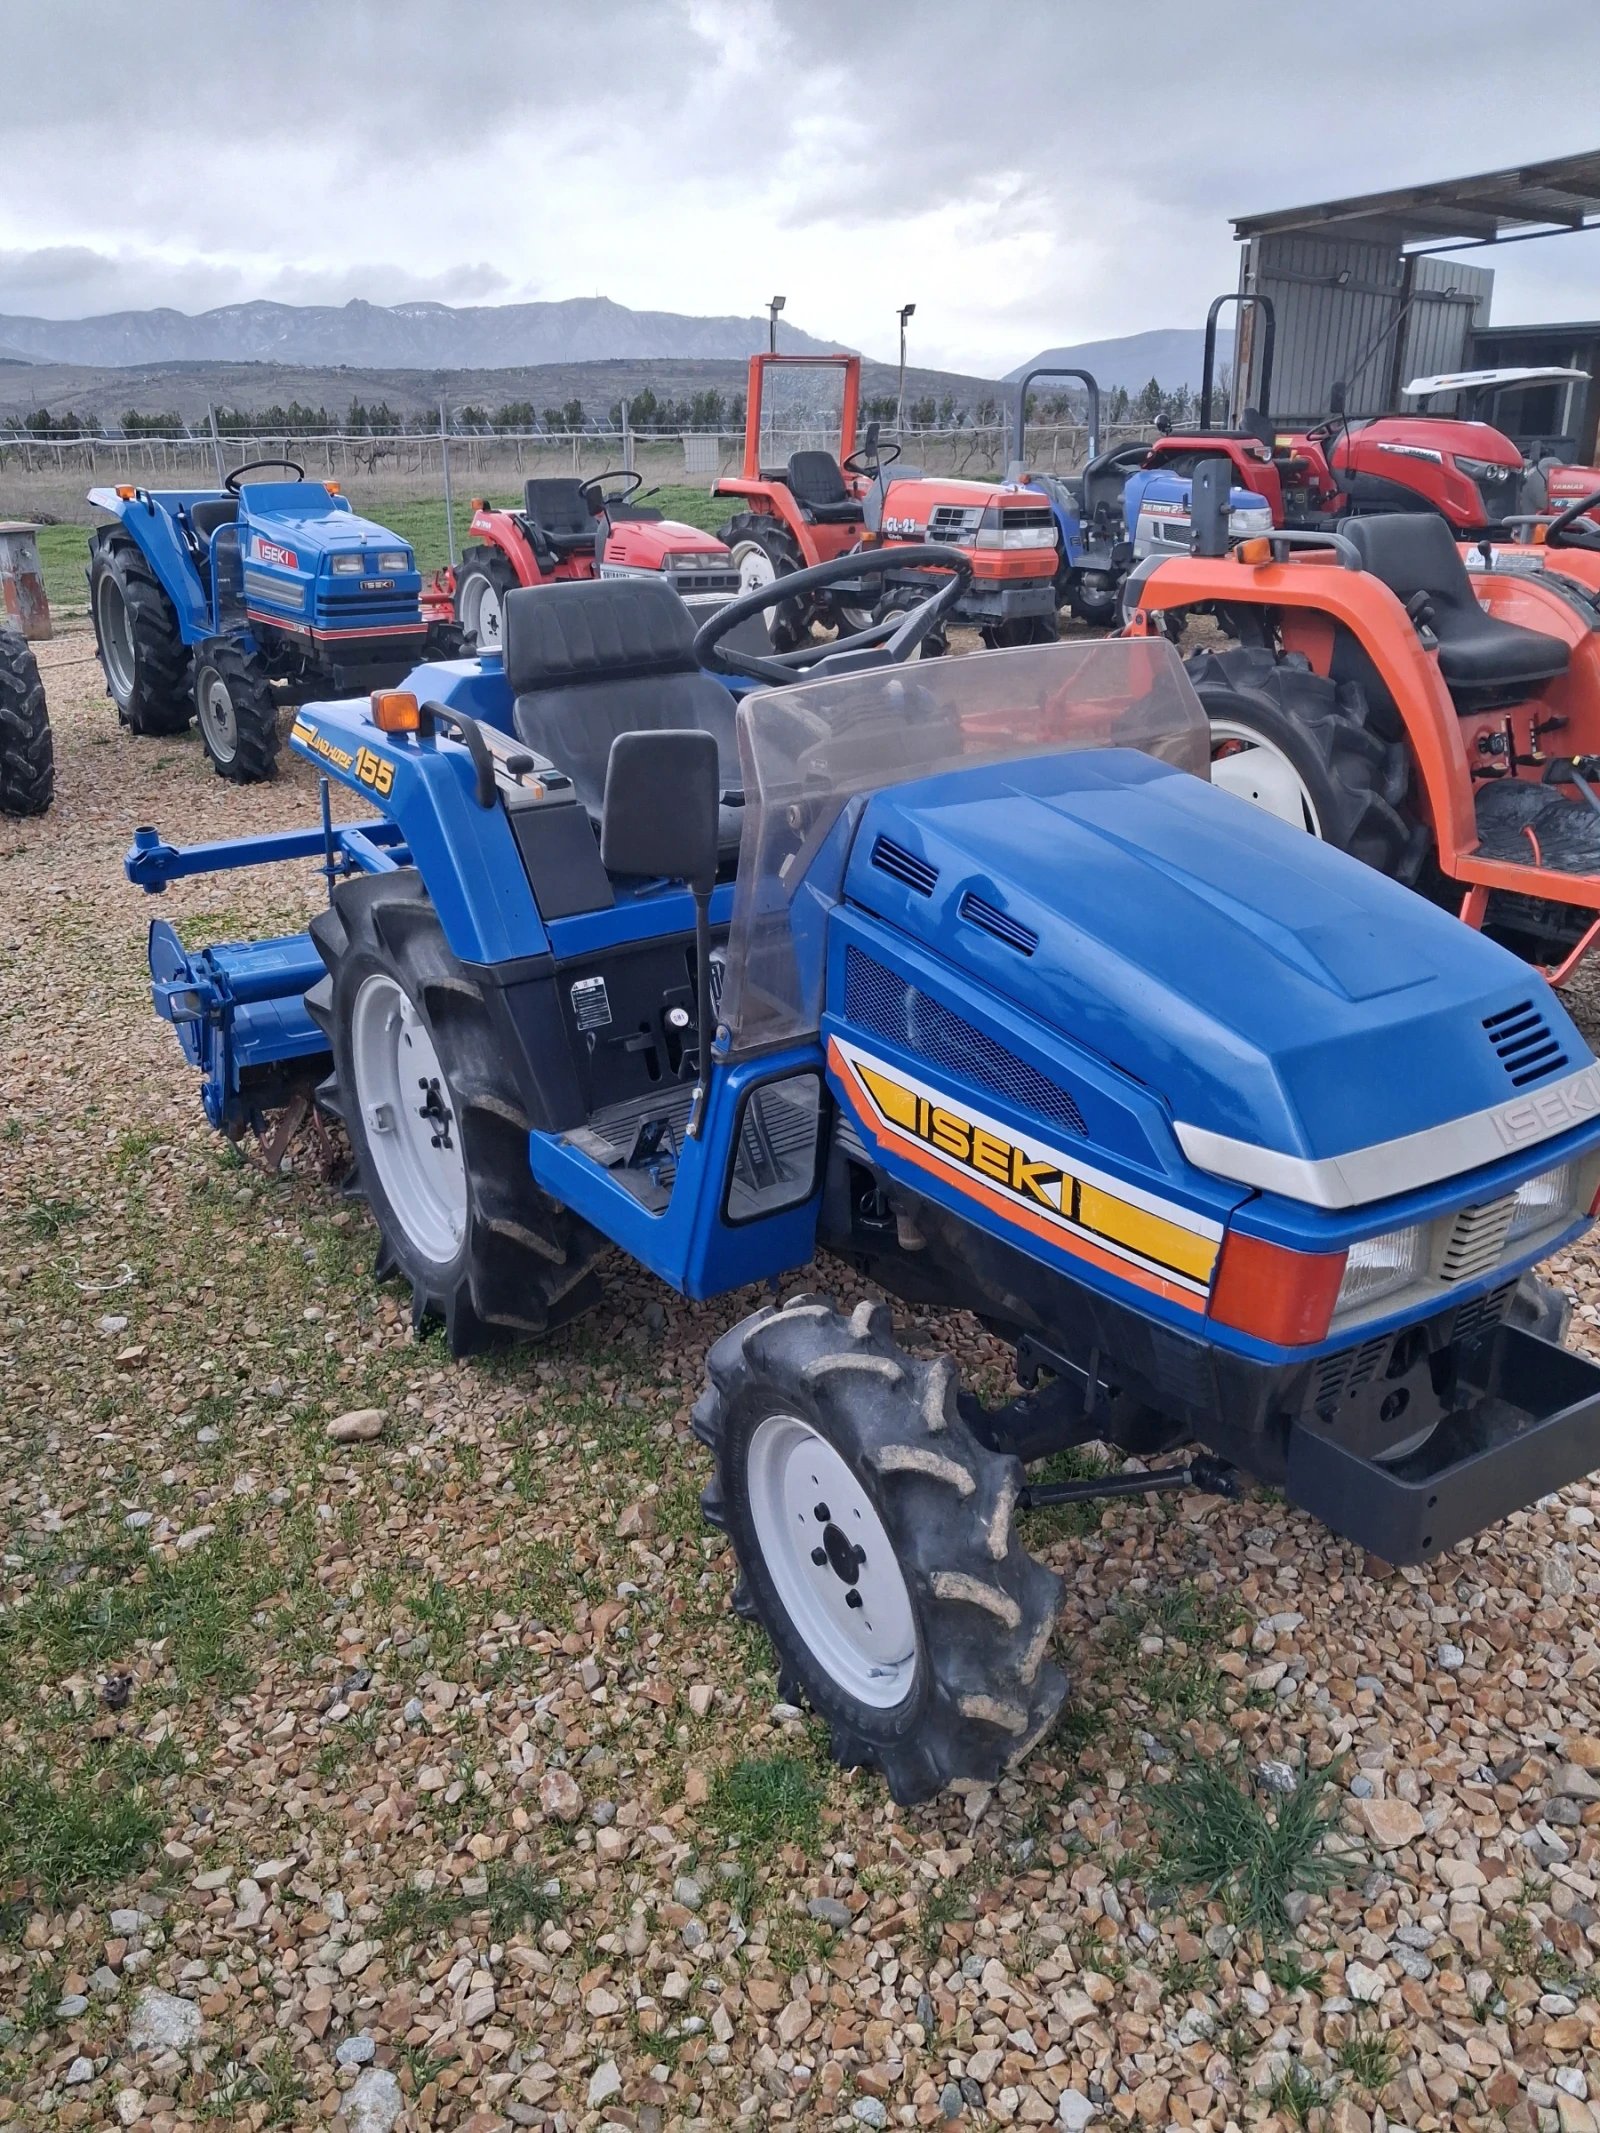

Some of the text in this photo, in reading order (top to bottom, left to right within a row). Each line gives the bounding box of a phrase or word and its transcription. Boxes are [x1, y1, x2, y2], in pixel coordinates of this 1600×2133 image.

[262, 544, 289, 565] ISEKI
[364, 580, 393, 589] ISEKI
[354, 745, 395, 795] 155
[1489, 1075, 1600, 1147] ISEKI
[919, 1097, 1076, 1217] ISEKI
